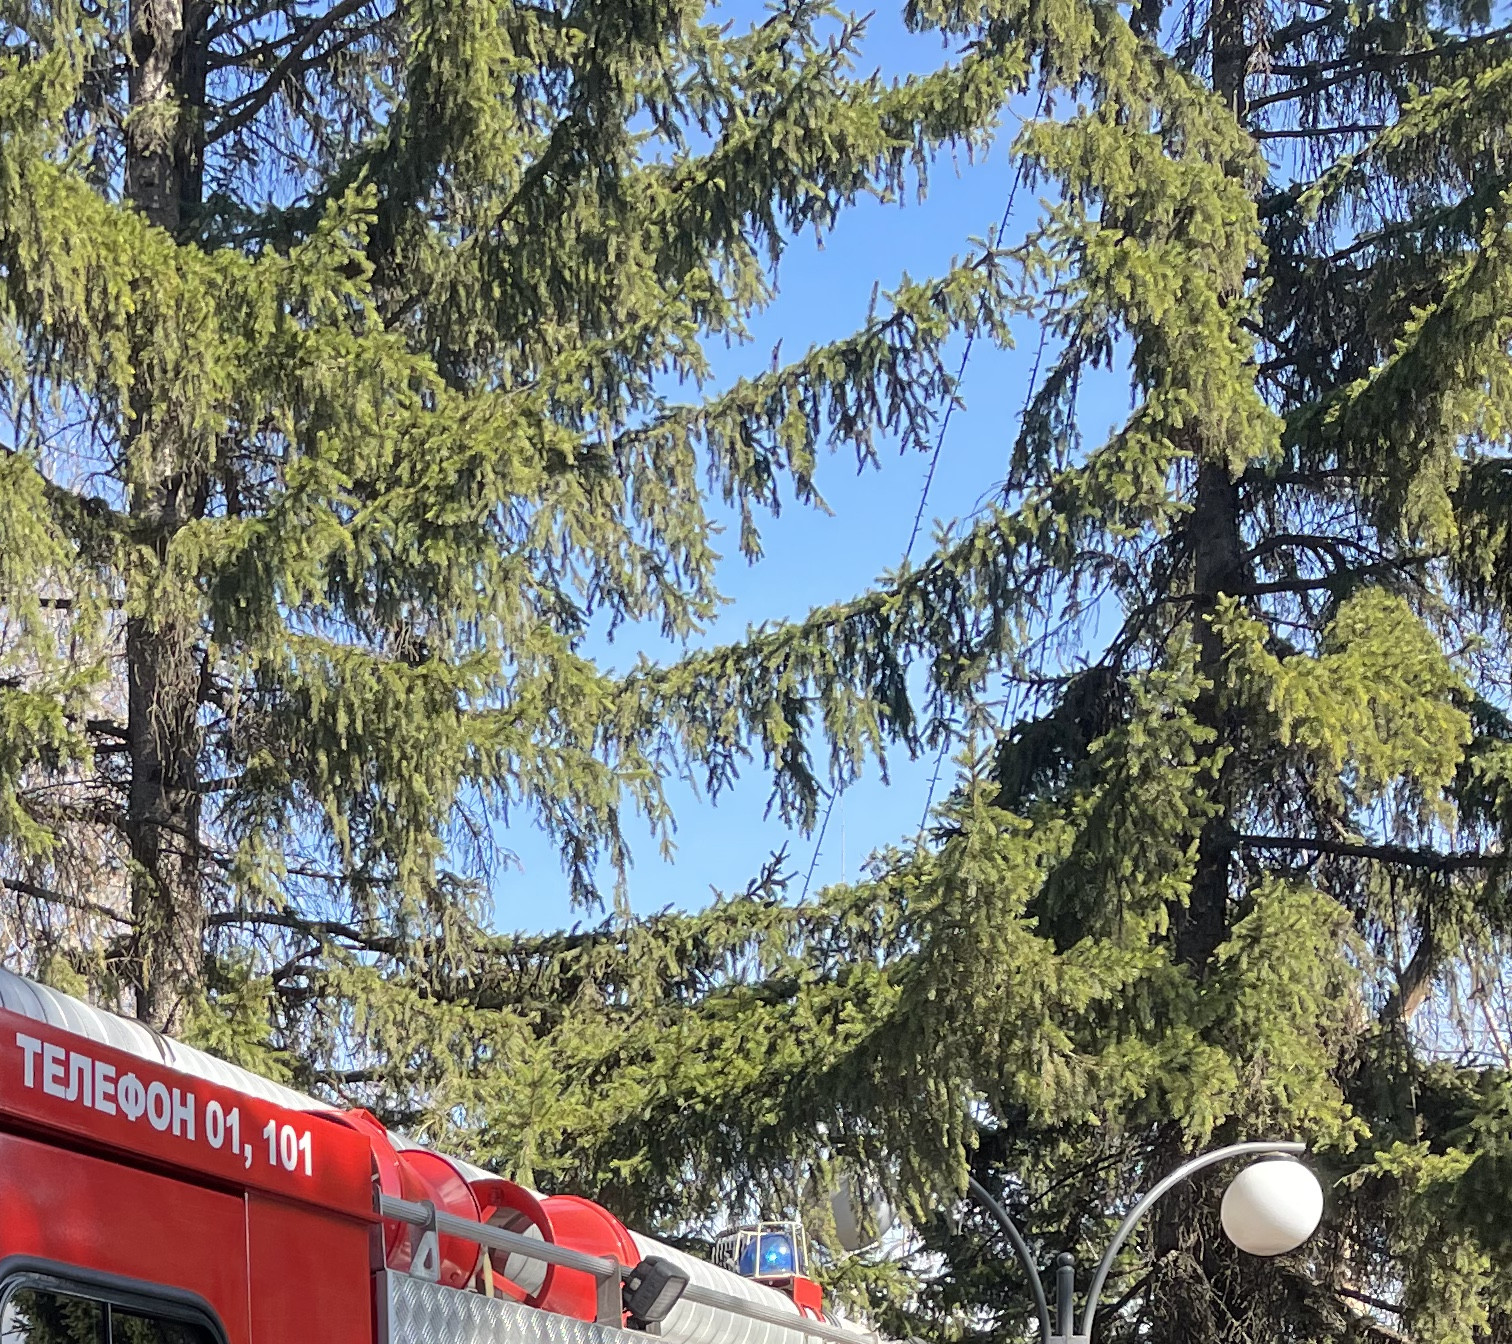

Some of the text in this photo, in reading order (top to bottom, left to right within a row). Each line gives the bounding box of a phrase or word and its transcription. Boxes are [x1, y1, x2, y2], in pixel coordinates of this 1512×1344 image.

[16, 1033, 313, 1177] ТЕЛЕФОН 01, 101
